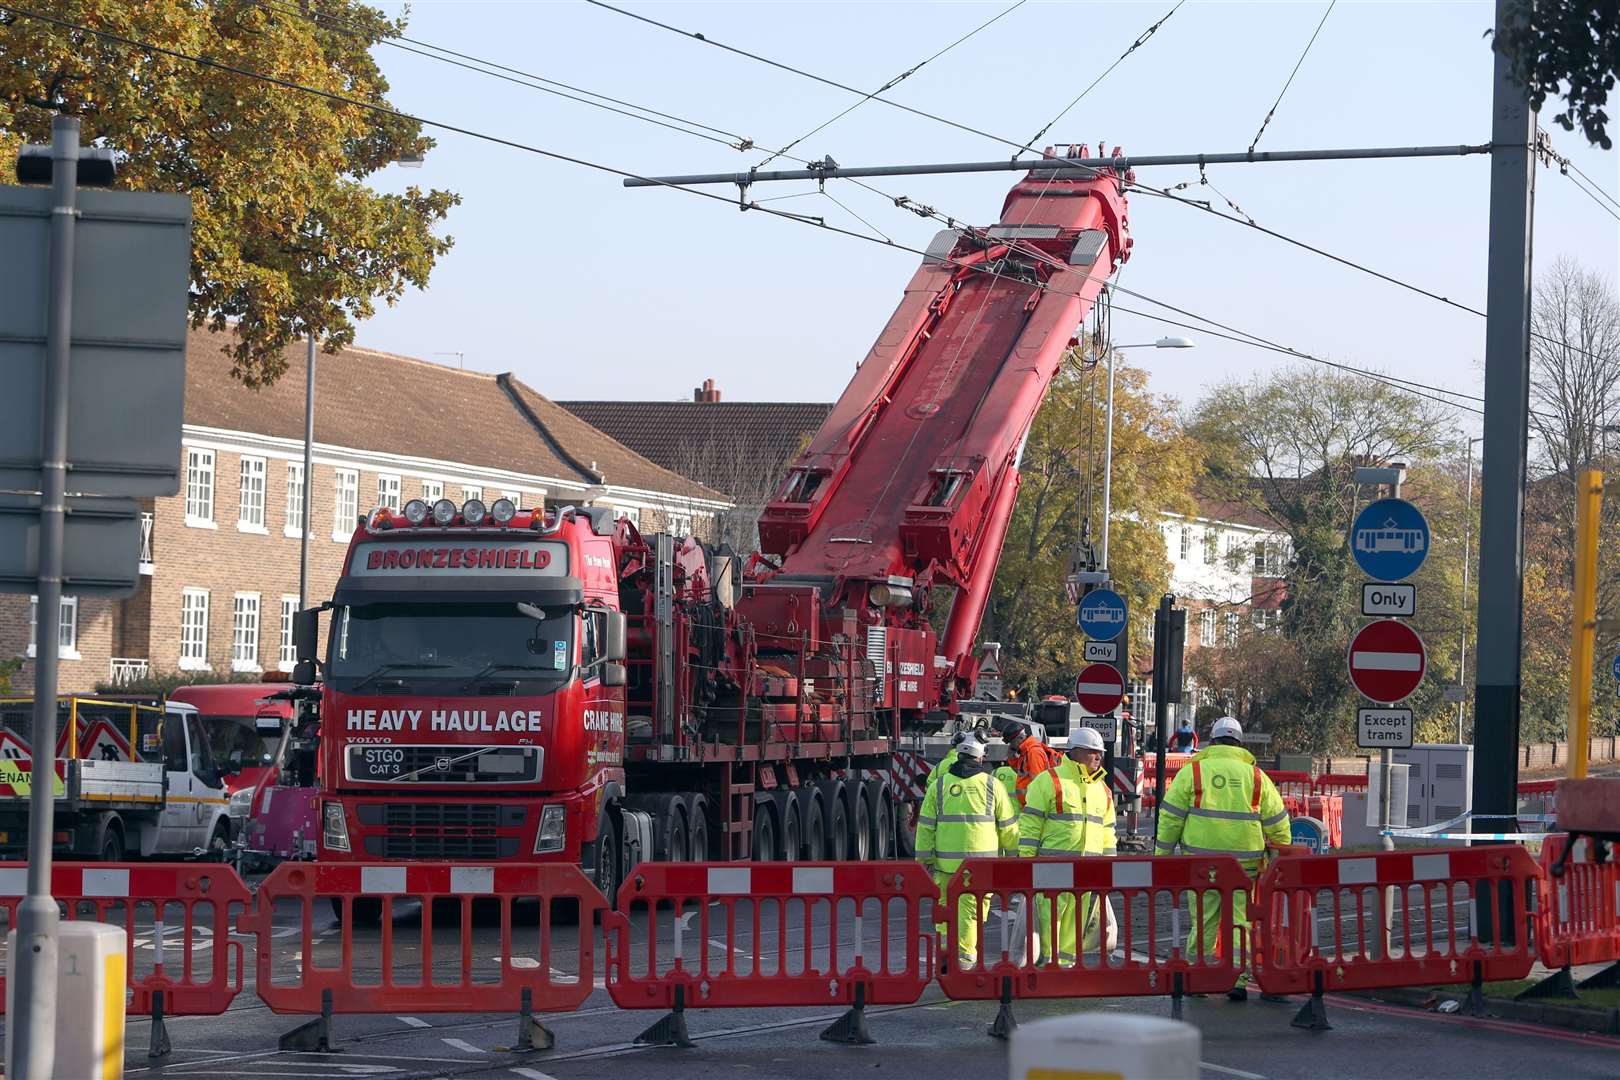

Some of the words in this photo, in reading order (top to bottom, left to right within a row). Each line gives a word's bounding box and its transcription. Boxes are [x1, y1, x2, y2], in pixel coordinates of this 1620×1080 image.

[367, 549, 552, 570] BRONZESHIELD
[1371, 591, 1407, 608] Only
[1089, 646, 1112, 657] Only
[347, 709, 423, 731] HEAVY
[431, 710, 542, 732] HAULAGE
[583, 709, 609, 731] CRANE
[609, 711, 623, 733] HIRE
[1085, 720, 1113, 731] Except
[1364, 714, 1407, 728] Except
[346, 736, 392, 744] VOLVO
[1367, 728, 1403, 740] trams
[365, 749, 404, 763] STGO
[369, 764, 390, 775] CAT
[392, 764, 400, 775] 3
